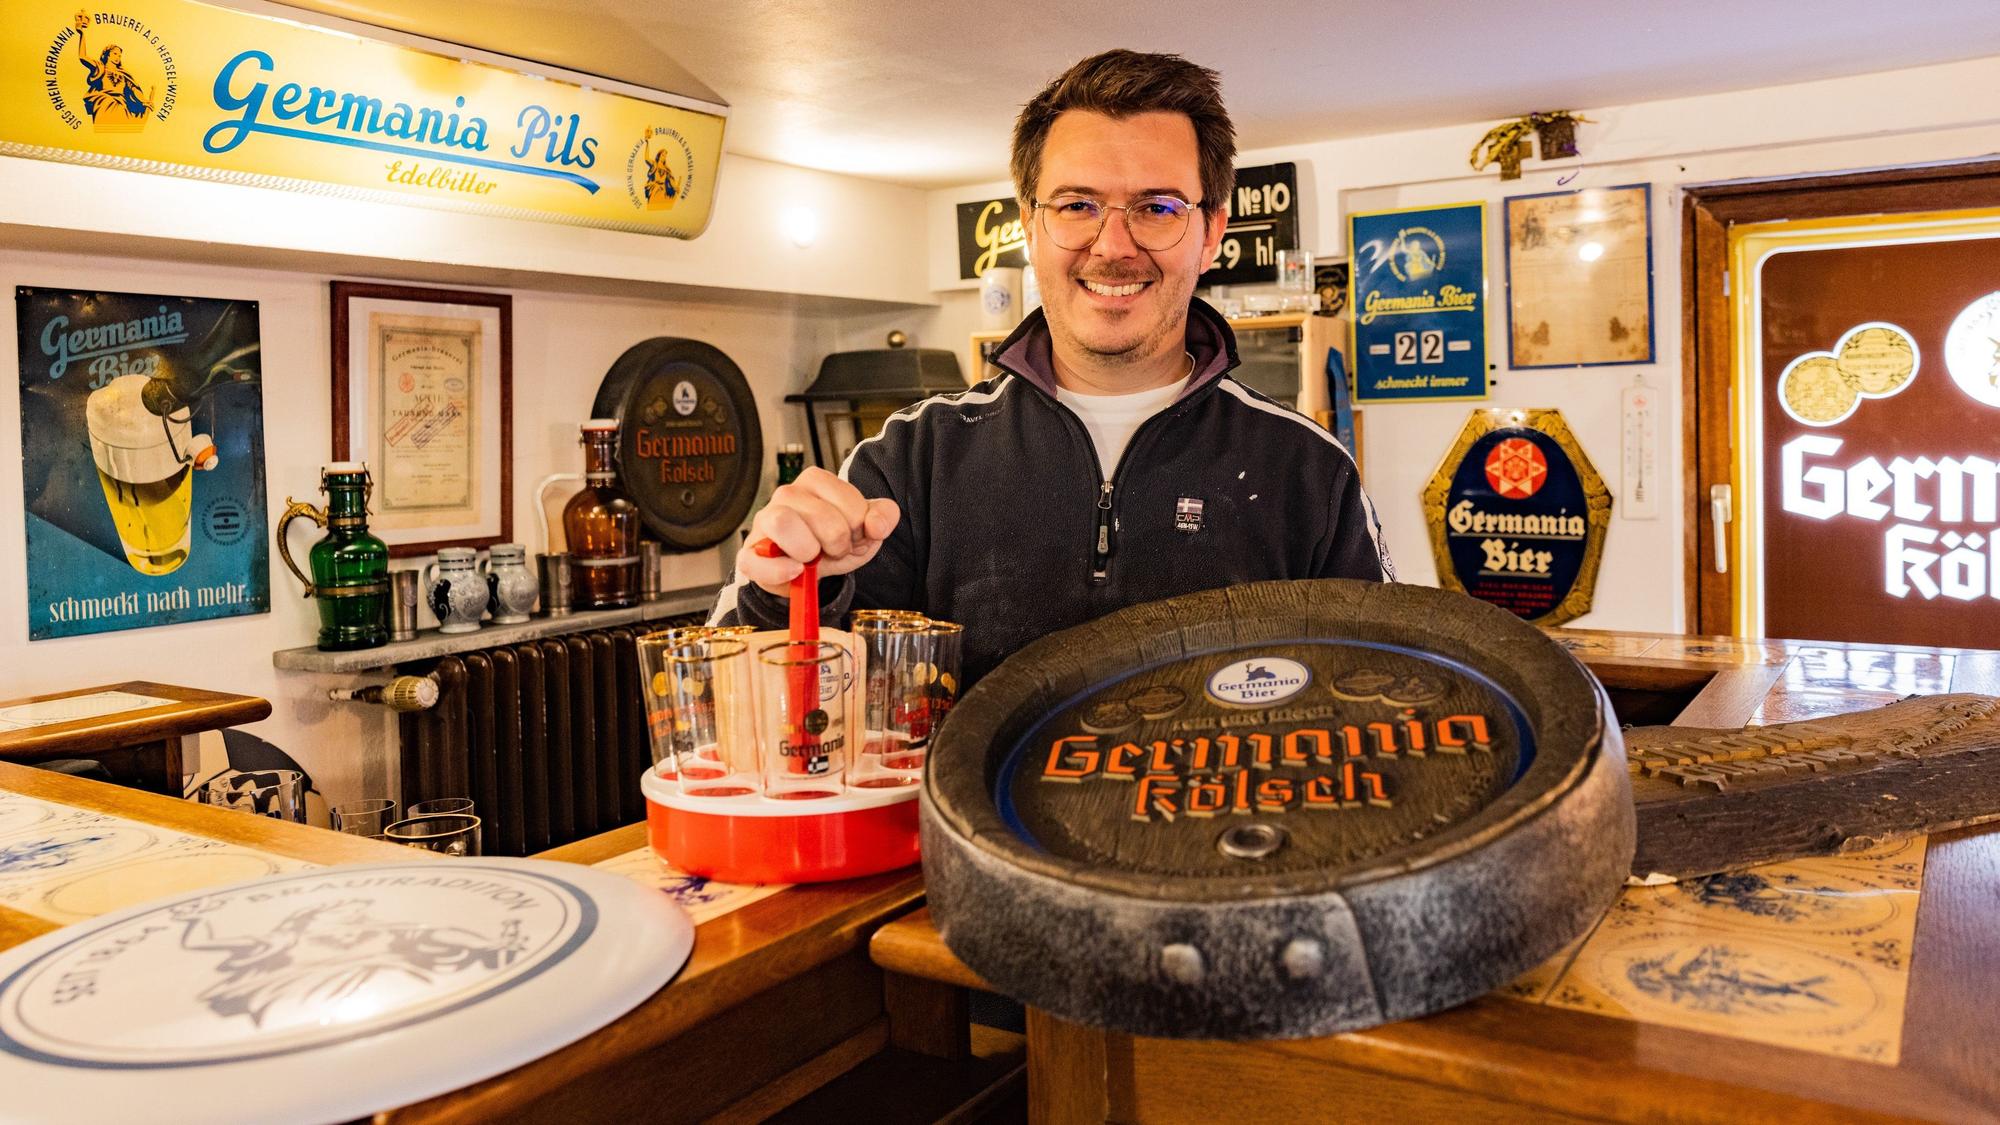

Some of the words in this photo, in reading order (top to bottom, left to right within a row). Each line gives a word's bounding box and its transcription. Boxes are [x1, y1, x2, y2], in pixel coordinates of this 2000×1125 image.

[45, 26, 75, 75] GERMANIA
[94, 13, 144, 34] BRAUEREI
[203, 50, 489, 154] Germania
[510, 104, 599, 169] Pils
[385, 160, 497, 196] Edelbitter
[1360, 288, 1435, 325] Germania
[1437, 284, 1477, 307] Bier
[41, 305, 185, 379] Germania
[1374, 376, 1428, 389] schmeckt
[1430, 375, 1470, 388] immer
[637, 428, 735, 459] Germania
[1448, 499, 1585, 536] Germania
[1480, 538, 1553, 573] Bier
[49, 591, 140, 623] schmeckt
[147, 585, 191, 612] nach
[1217, 677, 1300, 691] Germania
[1241, 689, 1277, 699] Bier
[1042, 708, 1492, 781] Germania
